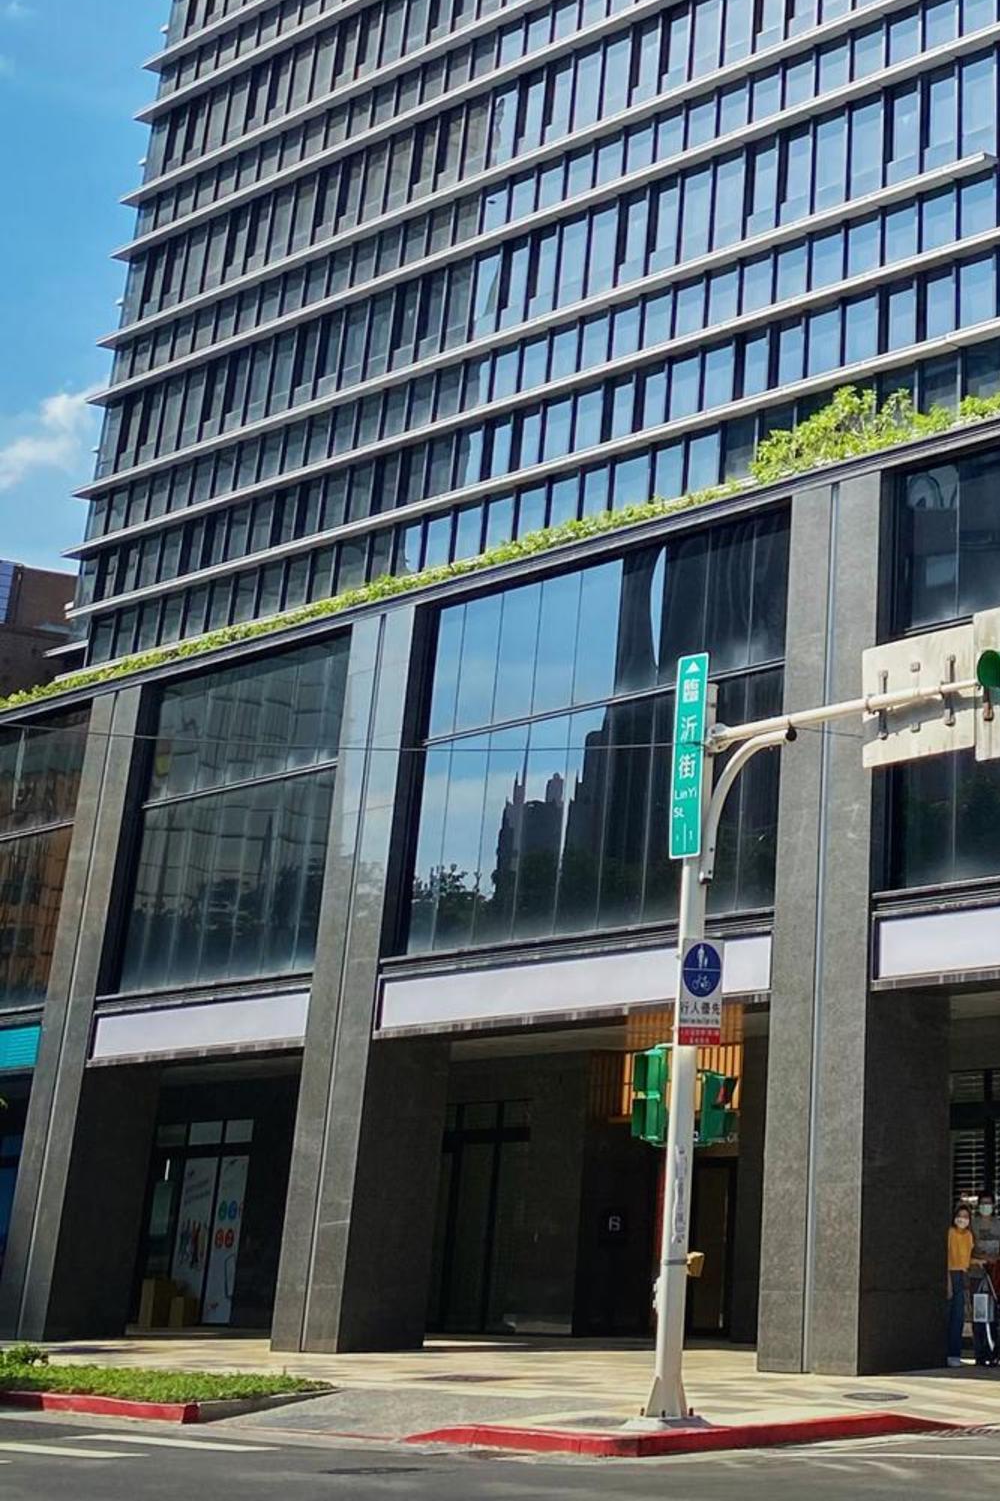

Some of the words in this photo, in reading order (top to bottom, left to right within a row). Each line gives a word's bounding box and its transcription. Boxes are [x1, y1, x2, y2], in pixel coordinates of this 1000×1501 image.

[679, 678, 700, 780] 臨沂街
[680, 1000, 720, 1015] 行人優先
